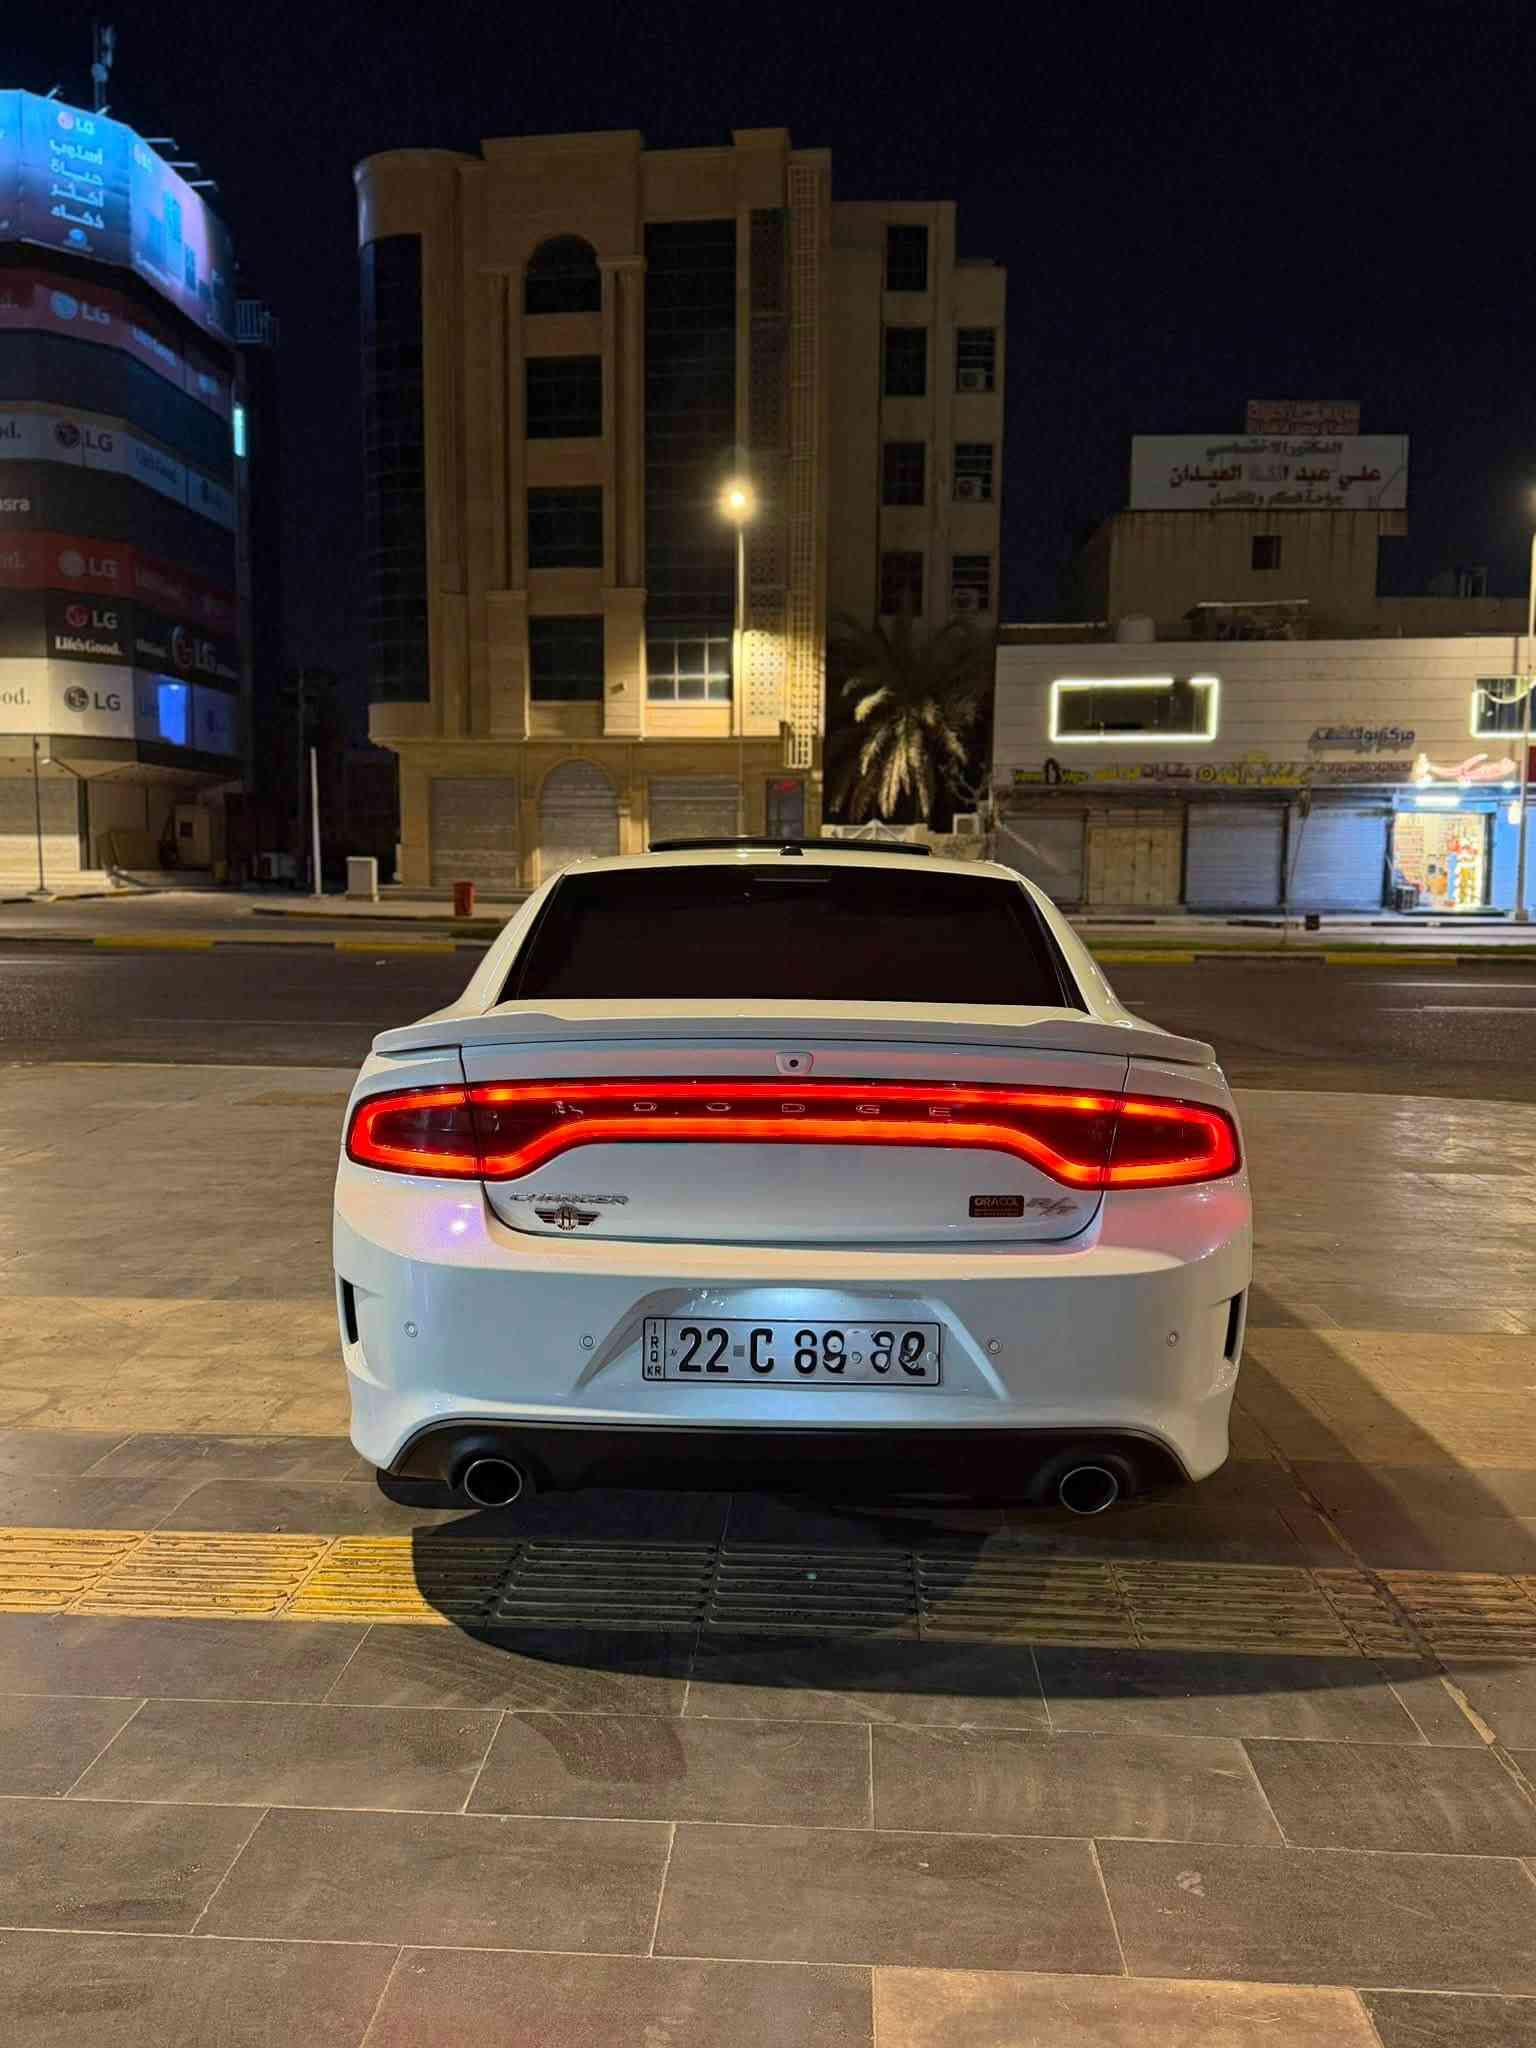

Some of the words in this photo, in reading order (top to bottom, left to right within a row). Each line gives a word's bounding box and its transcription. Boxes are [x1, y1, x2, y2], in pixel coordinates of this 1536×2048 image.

[86, 429, 112, 452] LG
[1338, 465, 1381, 490] علي
[90, 559, 117, 577] LG
[92, 610, 118, 629] LG
[94, 693, 120, 711] LG
[633, 1102, 952, 1118] DODGE
[679, 1327, 728, 1373] 22
[750, 1328, 774, 1374] C
